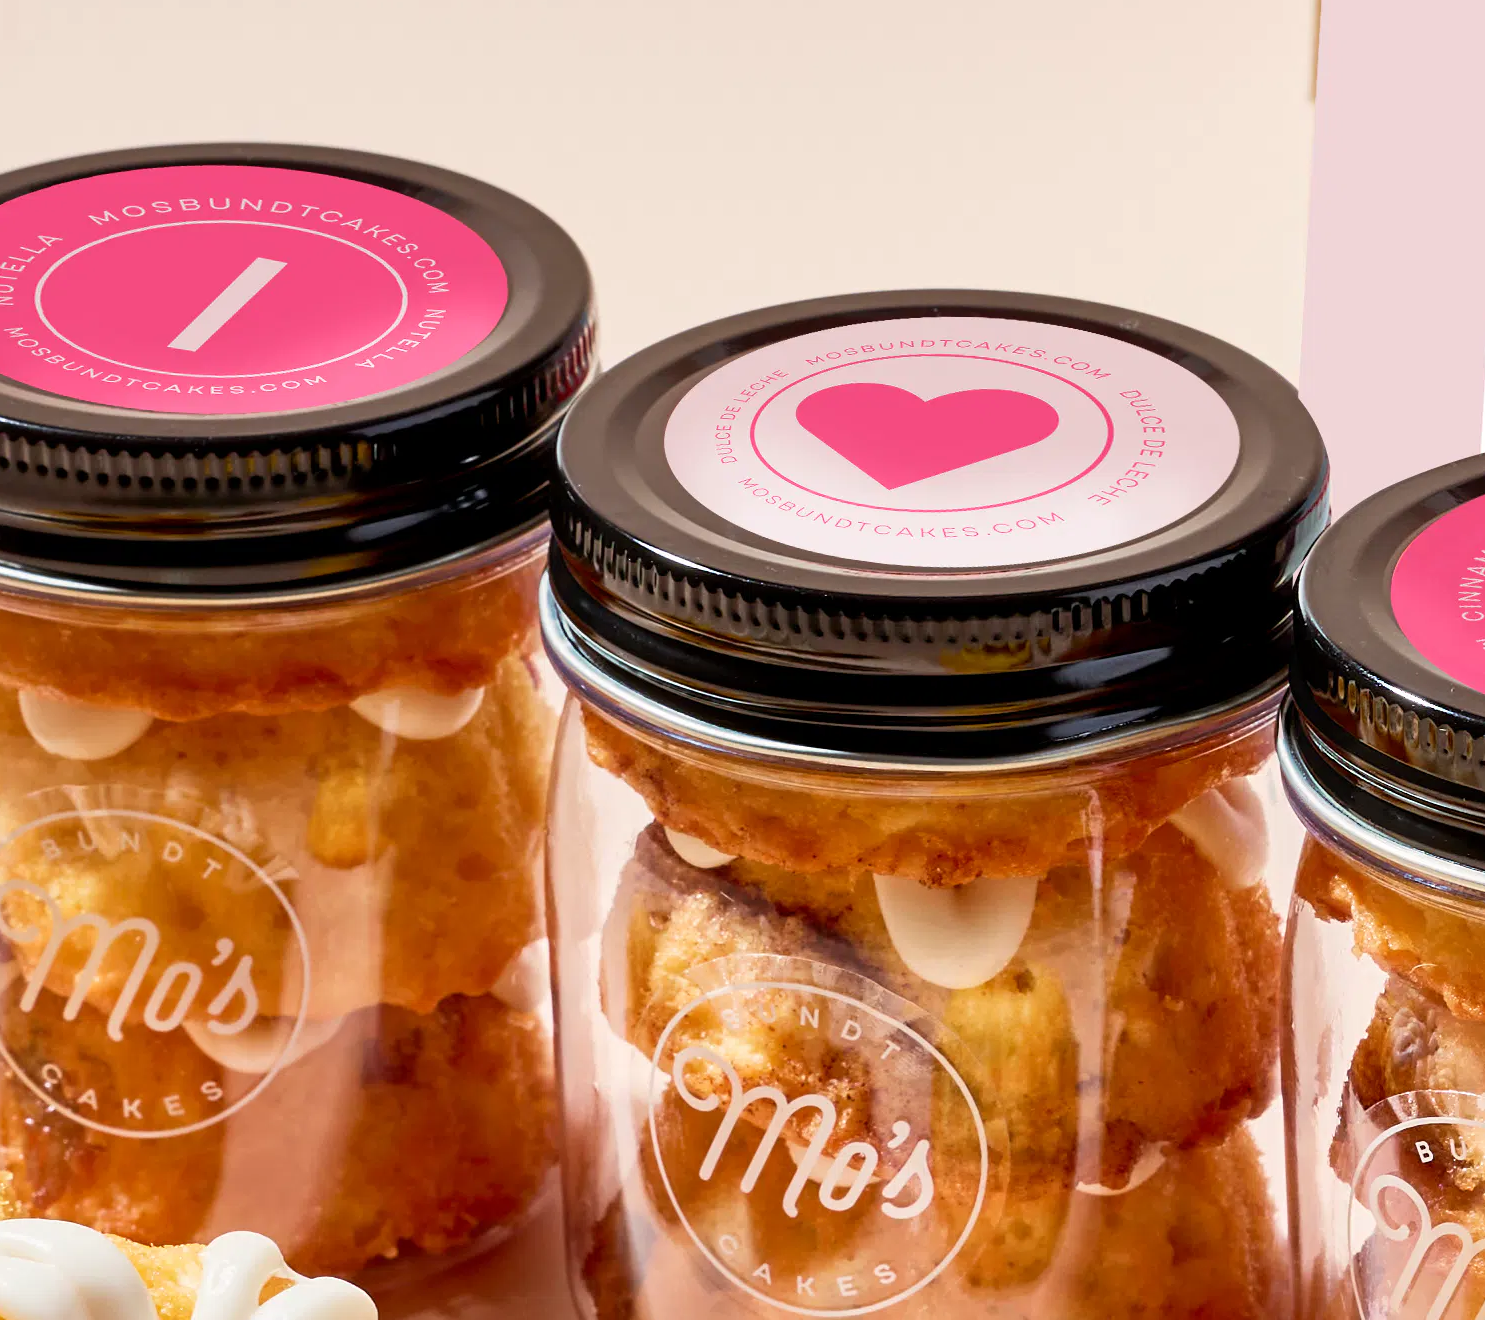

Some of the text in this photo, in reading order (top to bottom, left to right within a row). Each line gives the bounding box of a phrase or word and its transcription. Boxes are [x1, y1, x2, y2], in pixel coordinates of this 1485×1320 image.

[87, 197, 451, 296] MOSBUNDTCAKES.COM
[3, 325, 328, 396] MOSBUNDTCAKES.COM
[354, 308, 447, 370] NUTELLA
[804, 338, 1112, 381] MOSBUNDTCAKES.COM
[714, 369, 790, 465] DULCE DE LECHE
[1086, 389, 1166, 507] DULCE DE LECHE
[737, 476, 1065, 540] MOSBUNDTCAKES.COM
[39, 830, 223, 880] BUNDT
[720, 1004, 901, 1061] BUNDT
[39, 1062, 225, 1120] CAKES
[672, 1045, 935, 1220] Mo's
[718, 1233, 898, 1297] CAKES
